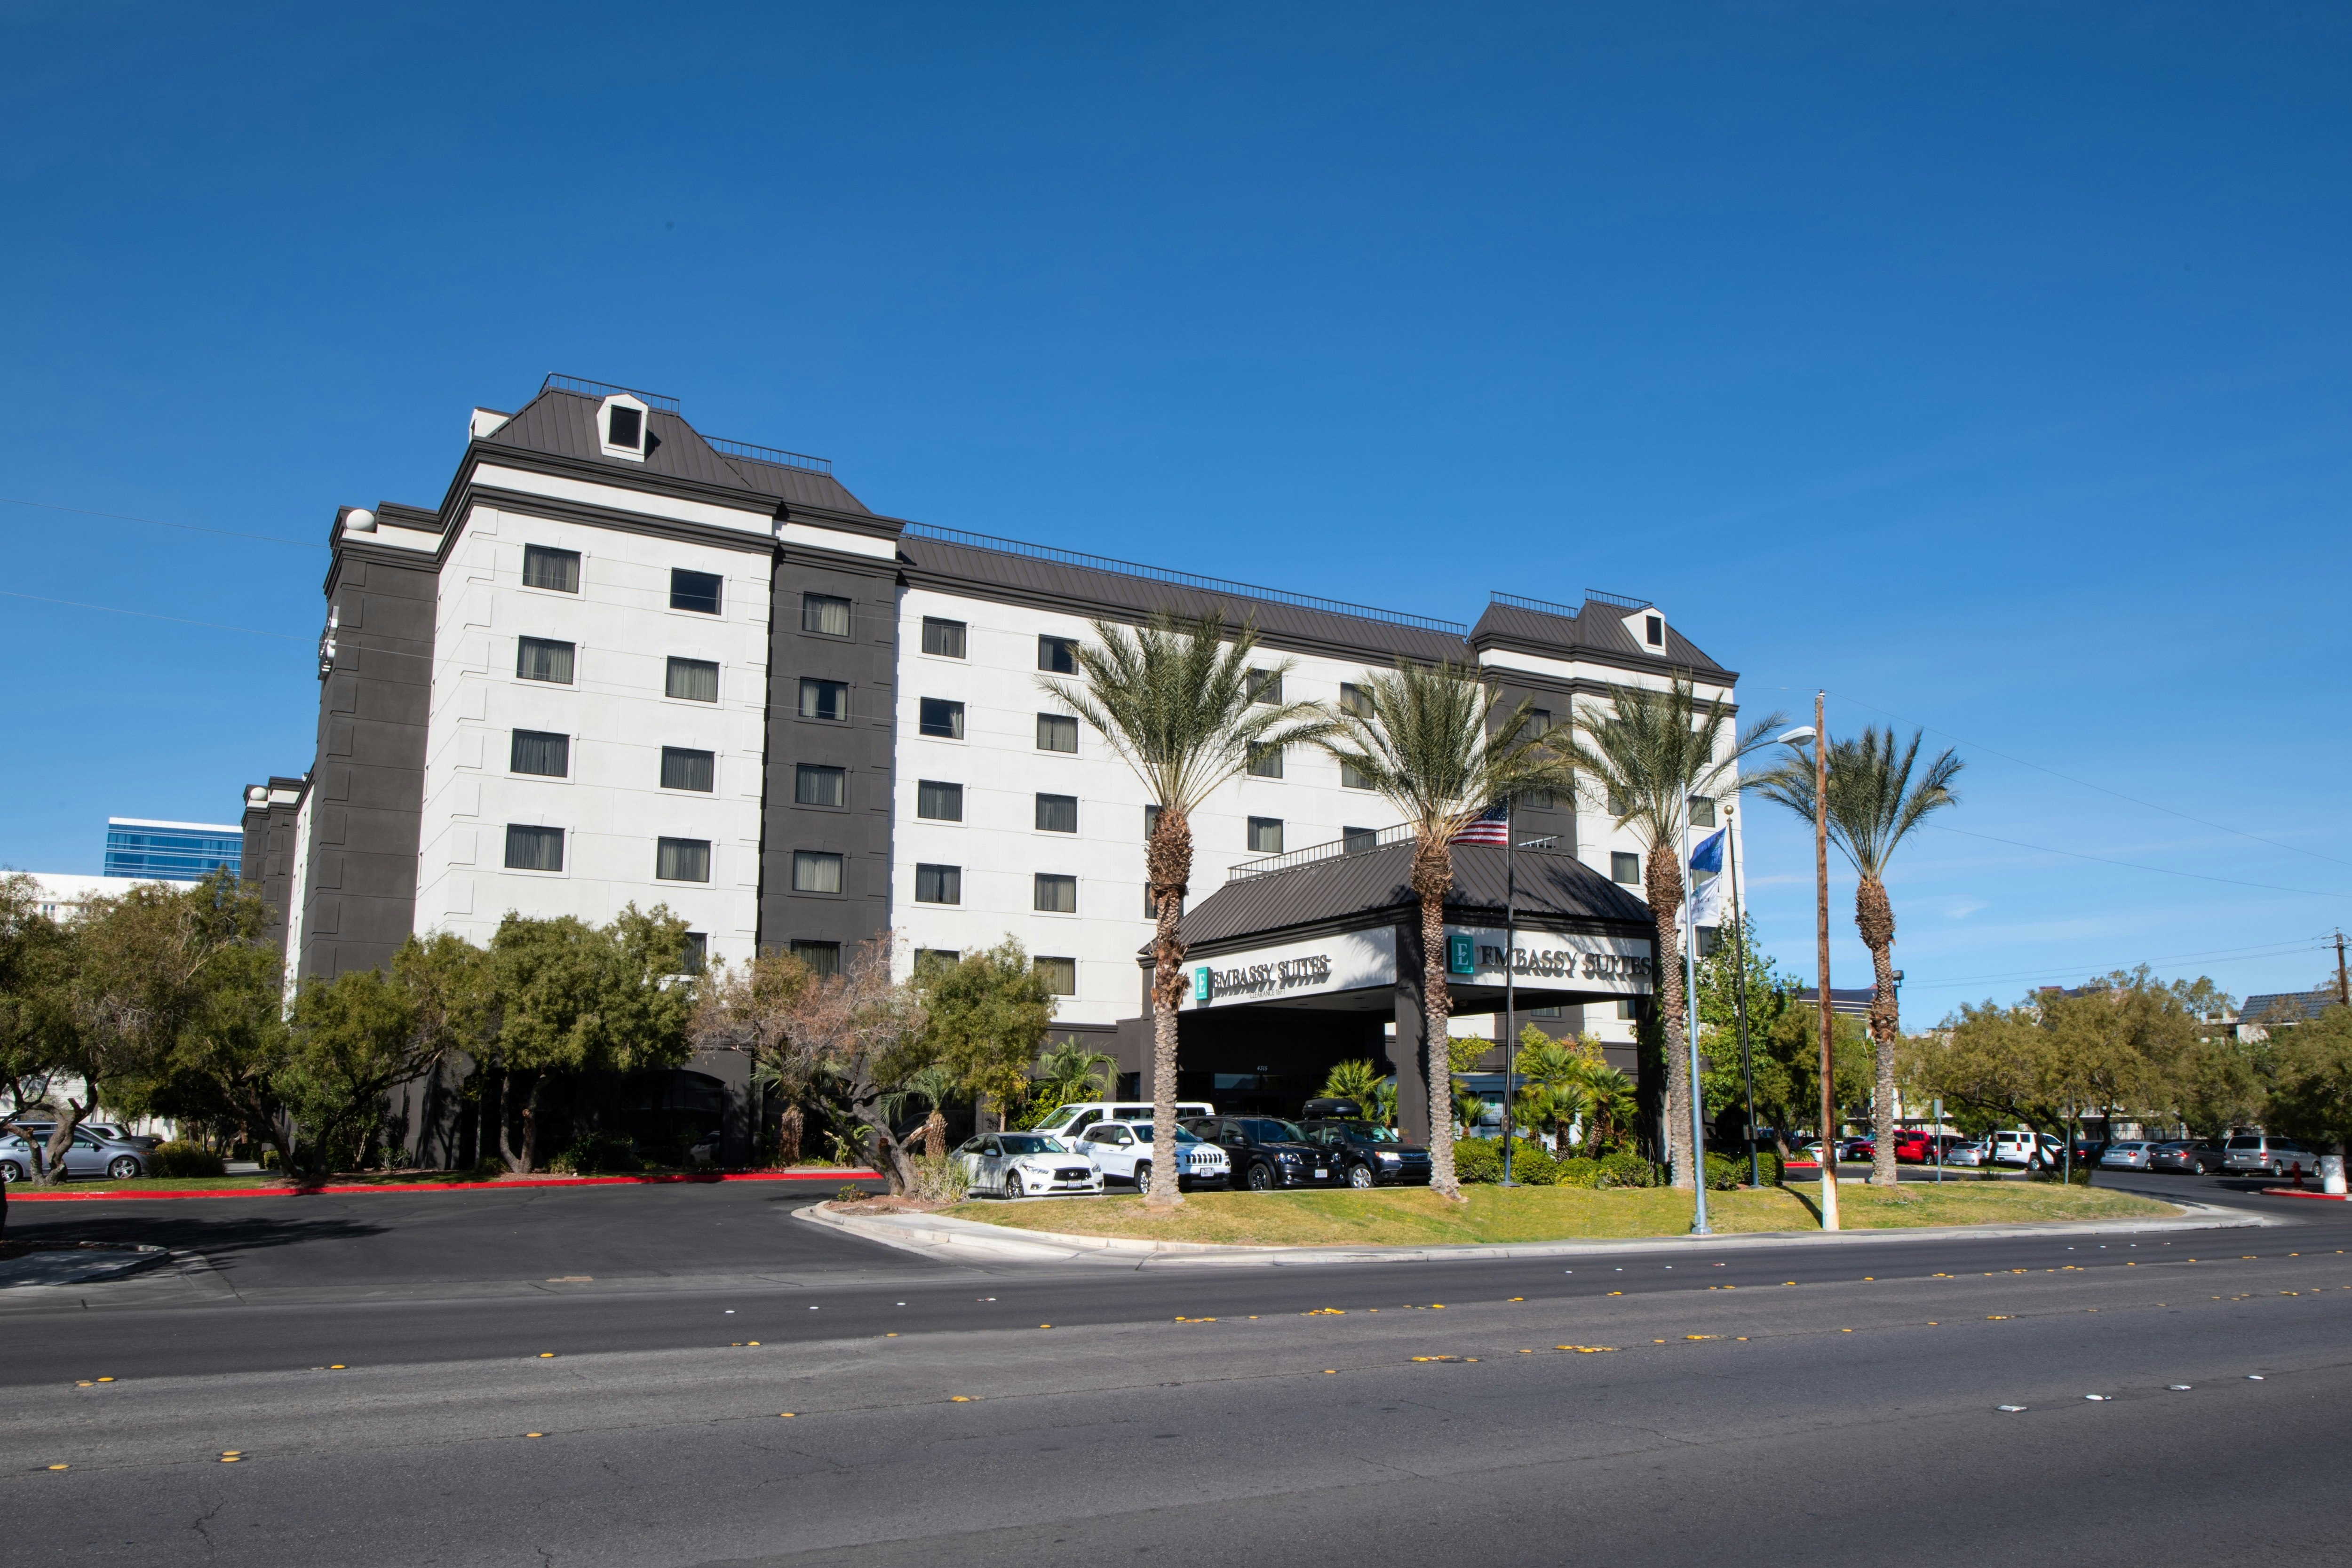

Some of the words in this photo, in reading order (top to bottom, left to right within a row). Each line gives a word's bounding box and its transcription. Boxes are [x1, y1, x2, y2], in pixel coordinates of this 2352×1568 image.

[1456, 943, 1469, 965] E
[1480, 946, 1577, 970] EMBASSY
[1585, 953, 1652, 975] SUITES
[1213, 963, 1273, 988] EMBASSY
[1278, 955, 1331, 979] SUITES
[1249, 989, 1275, 998] CLEARANCE
